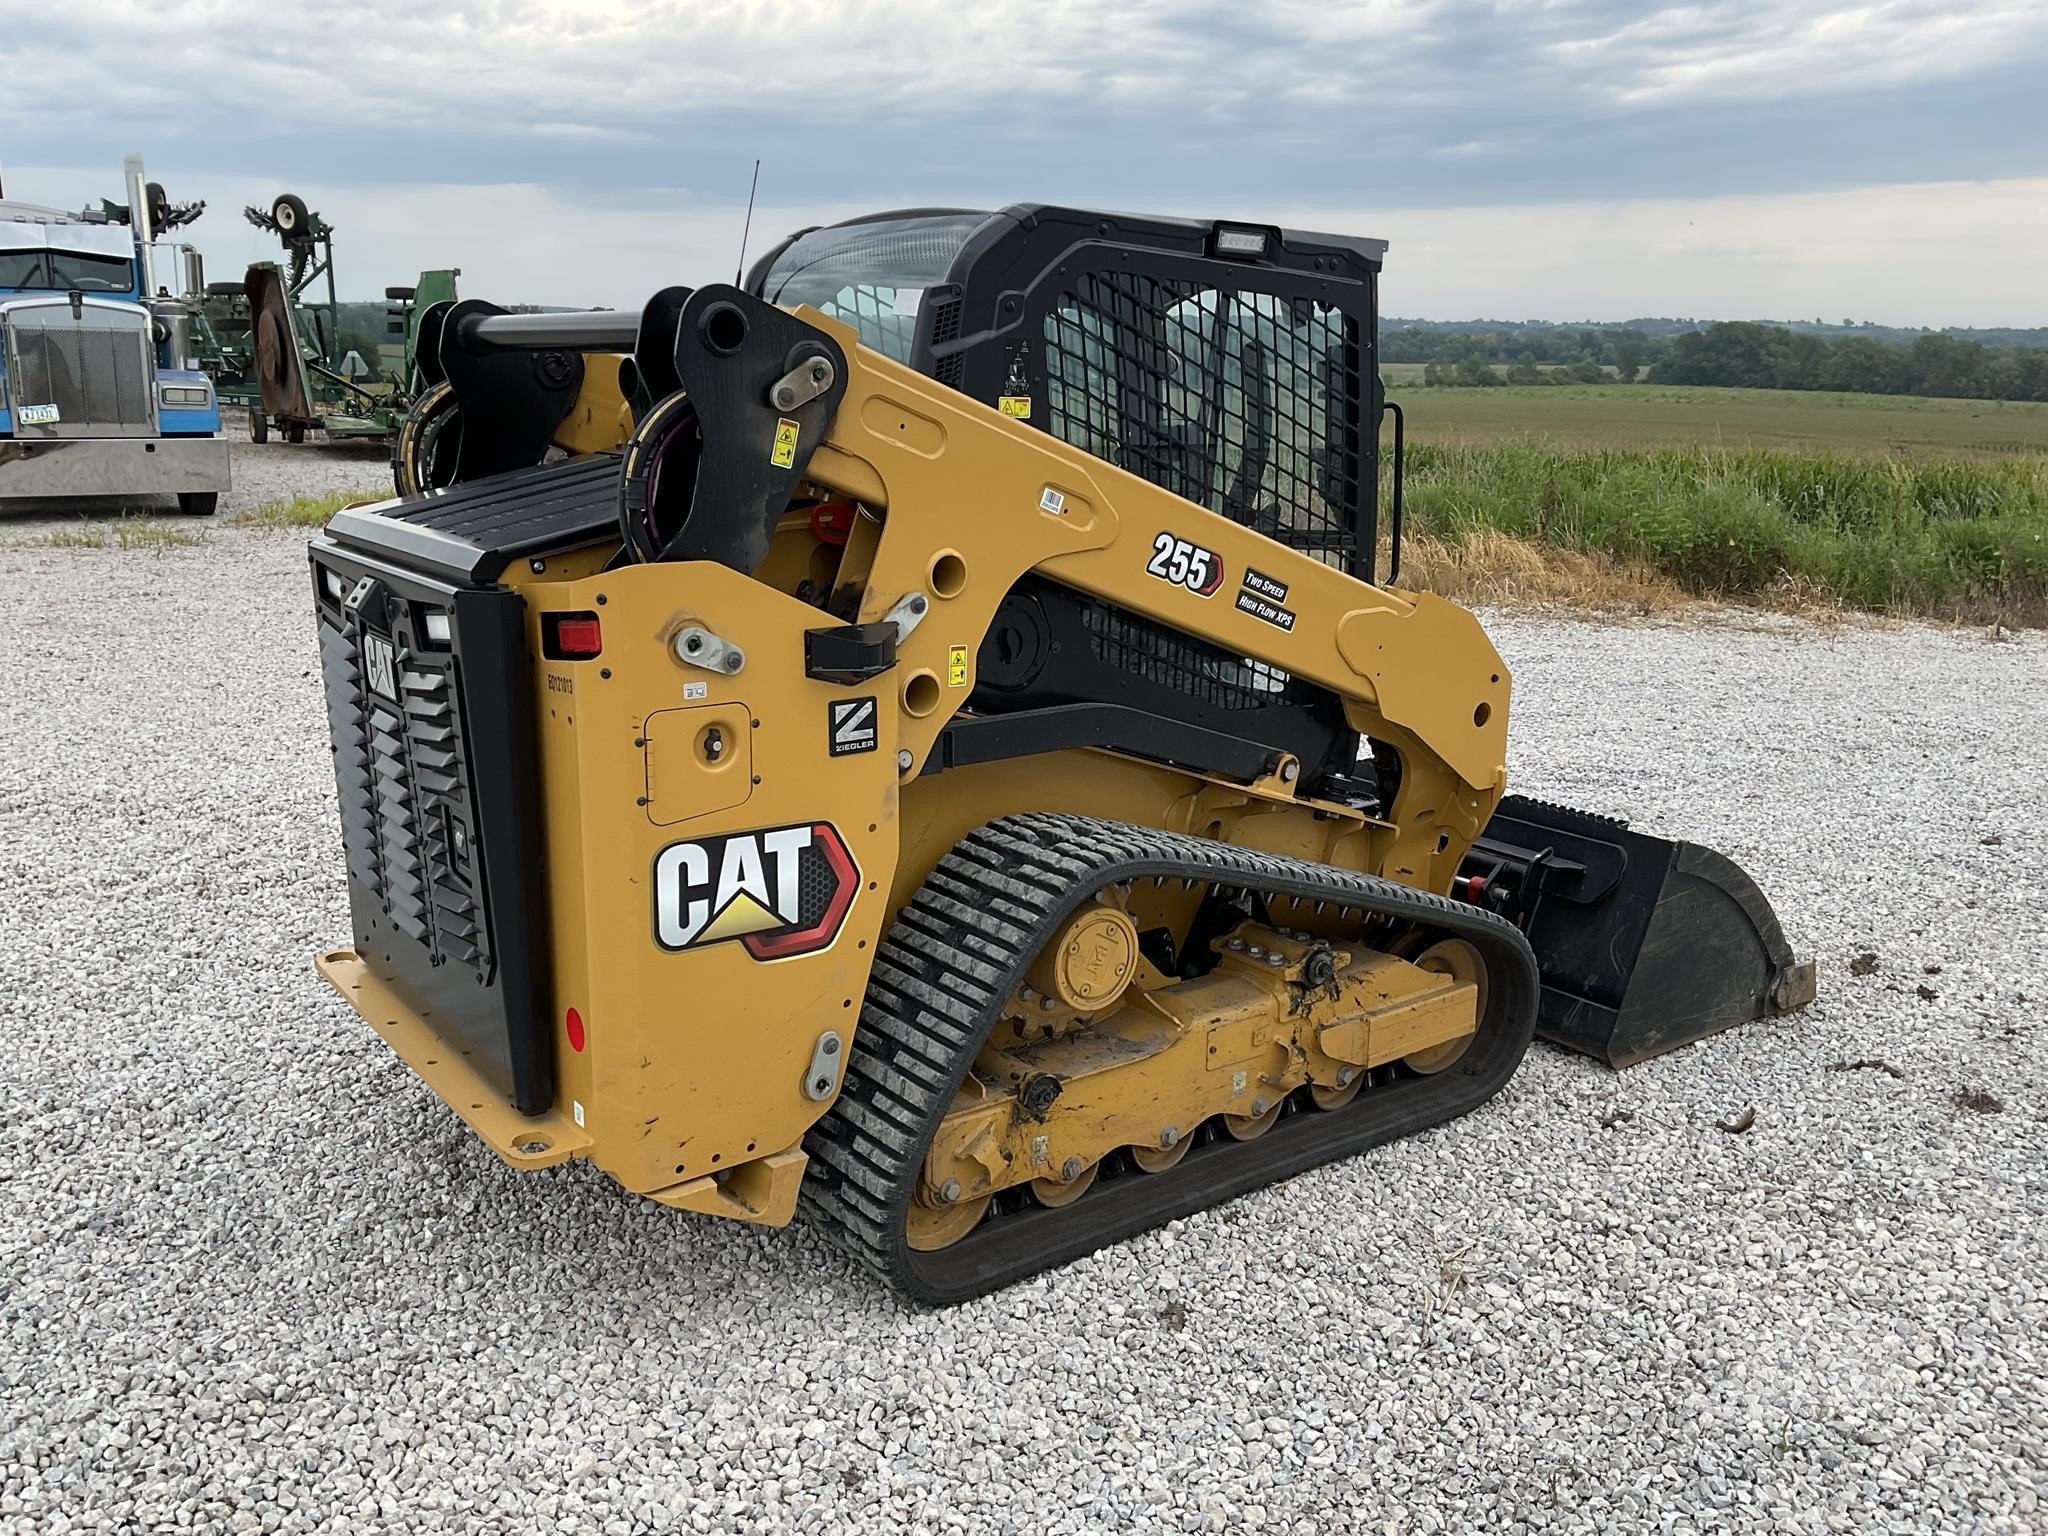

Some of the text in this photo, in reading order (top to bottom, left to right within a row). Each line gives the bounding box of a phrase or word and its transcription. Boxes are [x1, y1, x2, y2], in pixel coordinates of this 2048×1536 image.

[1149, 534, 1211, 589] 255
[1246, 572, 1285, 598] TWO SPEED
[1238, 594, 1293, 626] HIGH FLOW XPS
[364, 635, 397, 701] CAT
[835, 740, 874, 752] ZIEGLER
[656, 826, 812, 947] CAT
